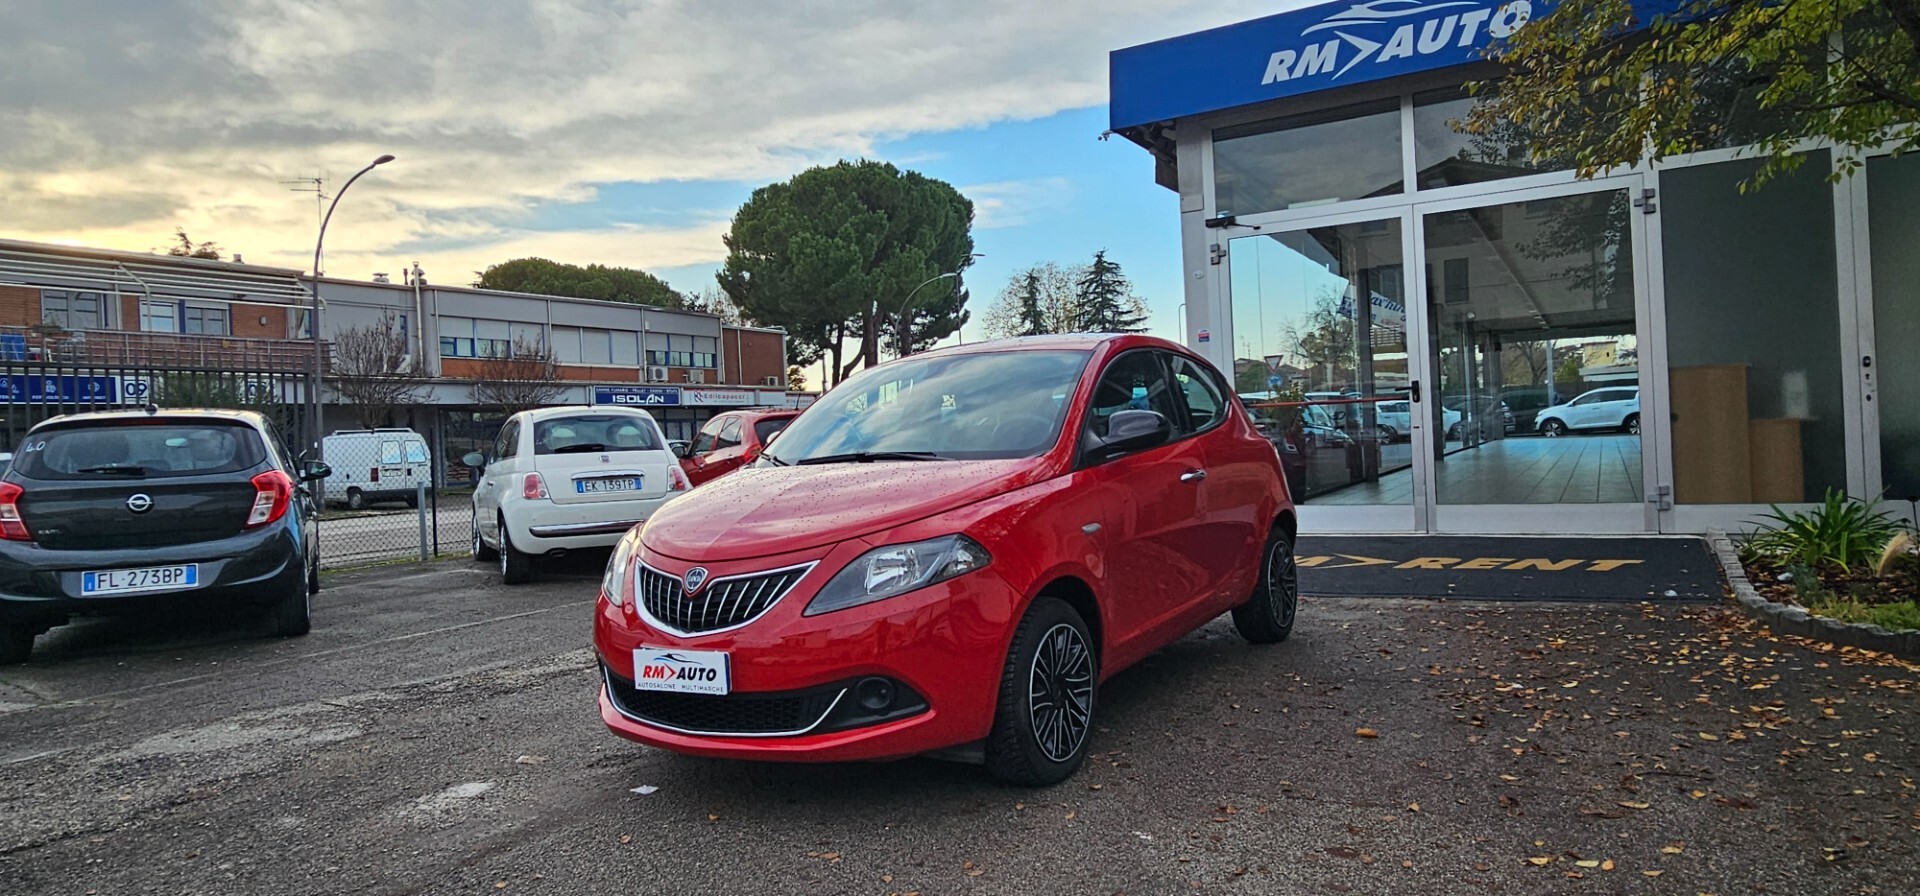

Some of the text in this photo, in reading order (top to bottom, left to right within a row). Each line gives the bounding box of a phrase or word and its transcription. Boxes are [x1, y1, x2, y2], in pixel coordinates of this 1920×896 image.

[1261, 0, 1532, 85] RM AUTO
[126, 383, 147, 396] 09
[612, 394, 664, 404] ISOLAN
[26, 441, 45, 452] 40
[584, 479, 633, 492] EK 139TP
[1393, 557, 1645, 571] RENT
[98, 573, 119, 588] FL
[127, 568, 183, 586] 273BP
[643, 665, 717, 682] RM AUTO
[682, 685, 723, 693] MULTIMARCHE
